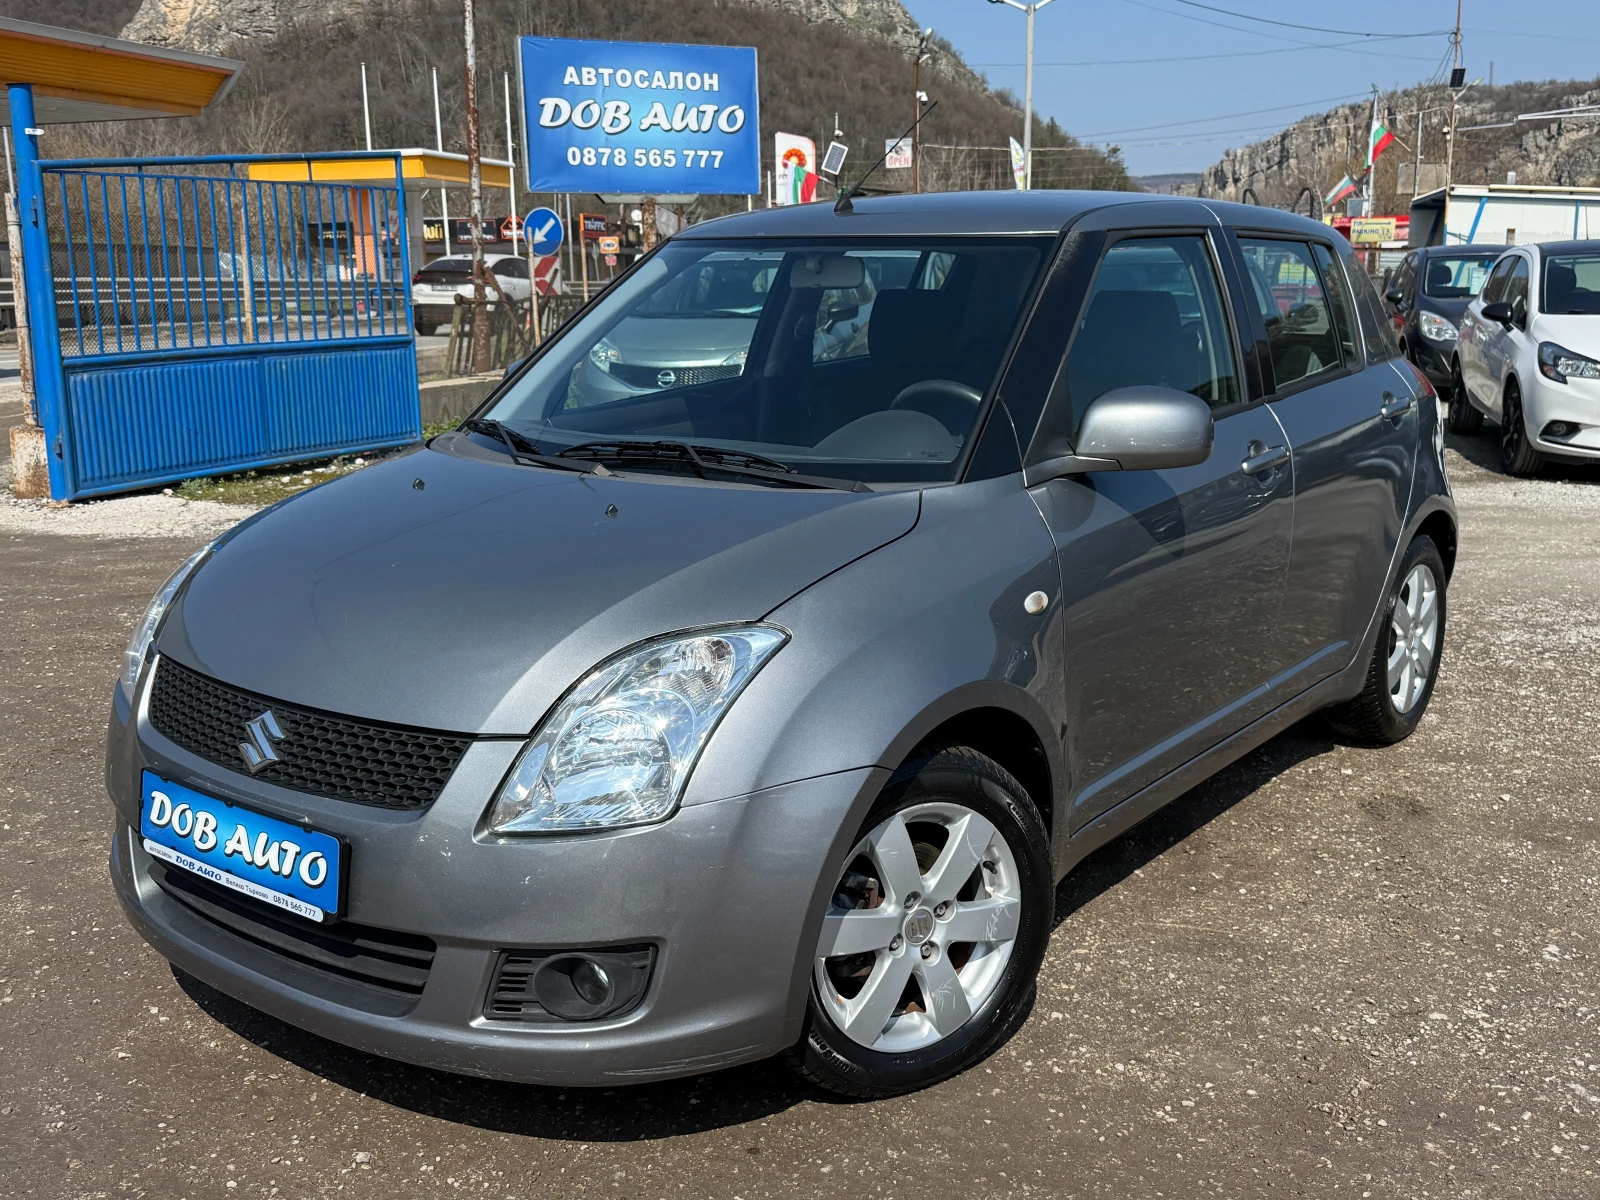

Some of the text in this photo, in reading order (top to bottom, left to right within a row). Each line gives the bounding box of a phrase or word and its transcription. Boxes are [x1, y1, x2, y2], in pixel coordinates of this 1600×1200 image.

[563, 66, 719, 91] АВТОСАЛОН
[539, 98, 745, 134] DOB AUTO
[567, 147, 724, 169] 0878 565 777
[888, 156, 910, 166] OPEN
[149, 790, 327, 886] DOB AUTO
[176, 855, 196, 871] DOB
[197, 865, 222, 881] AUTO
[273, 895, 289, 907] 0878
[290, 901, 303, 912] 565
[304, 906, 316, 917] 777
